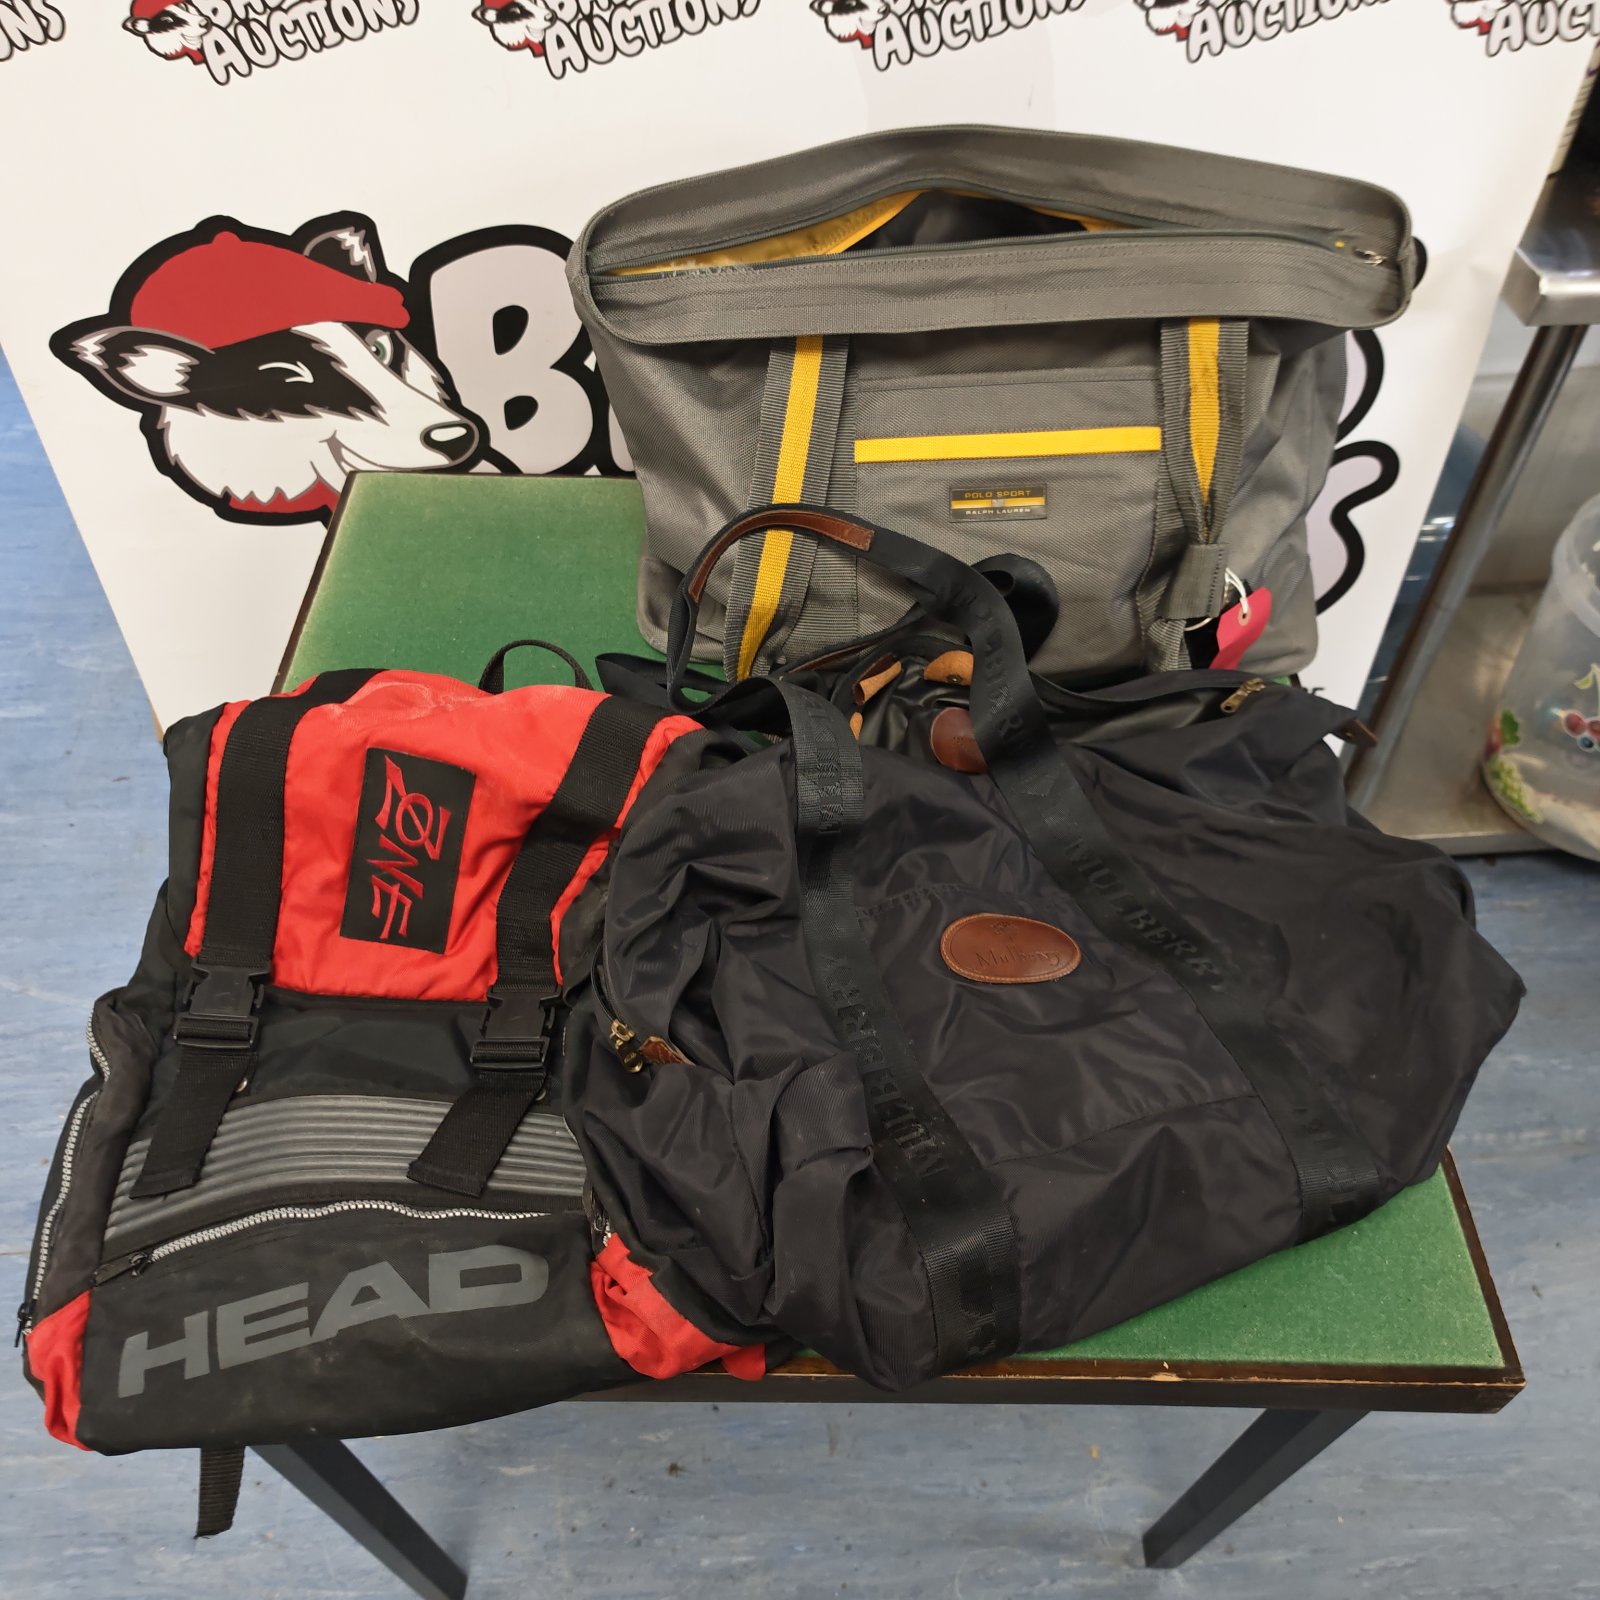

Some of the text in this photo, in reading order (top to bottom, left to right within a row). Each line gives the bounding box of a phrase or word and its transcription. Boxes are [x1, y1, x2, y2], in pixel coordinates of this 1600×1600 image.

[964, 490, 1032, 499] POLO SPORT
[996, 507, 1031, 515] LAUREN
[117, 1244, 550, 1399] HEAD
